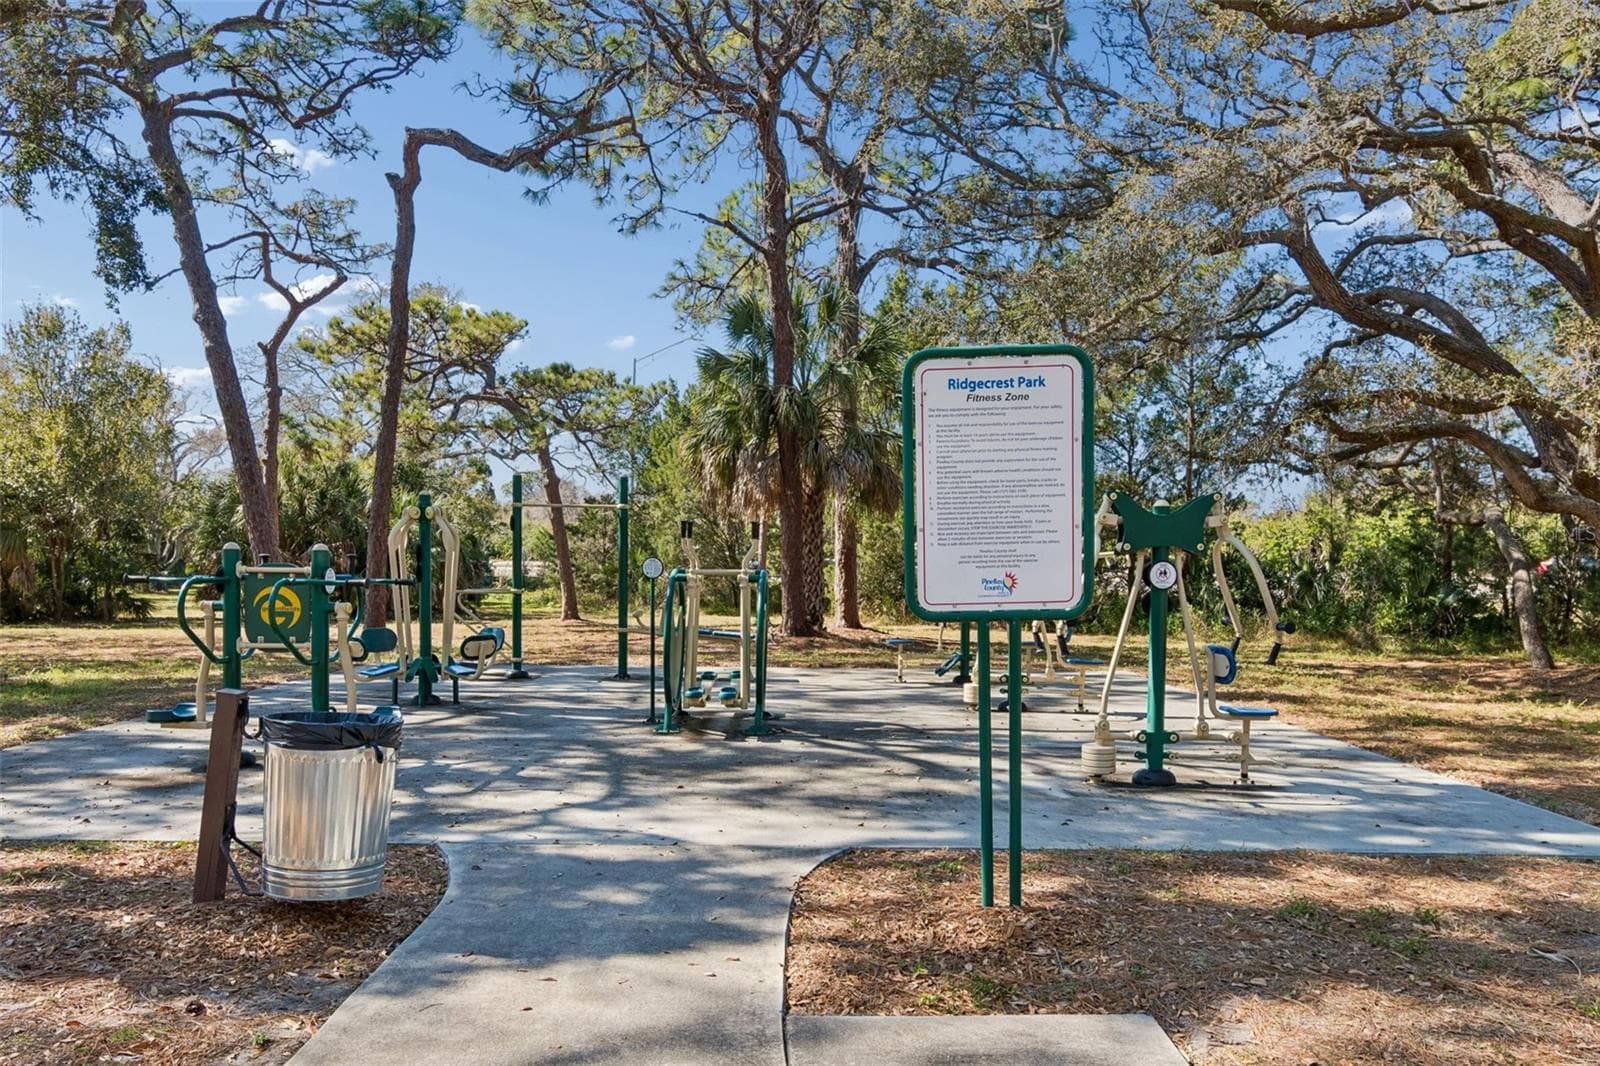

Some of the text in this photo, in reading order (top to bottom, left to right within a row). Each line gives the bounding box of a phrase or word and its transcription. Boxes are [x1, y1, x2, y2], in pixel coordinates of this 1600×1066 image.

[948, 376, 1046, 392] Ridgecrest Park
[966, 392, 1030, 402] Fitness Zone
